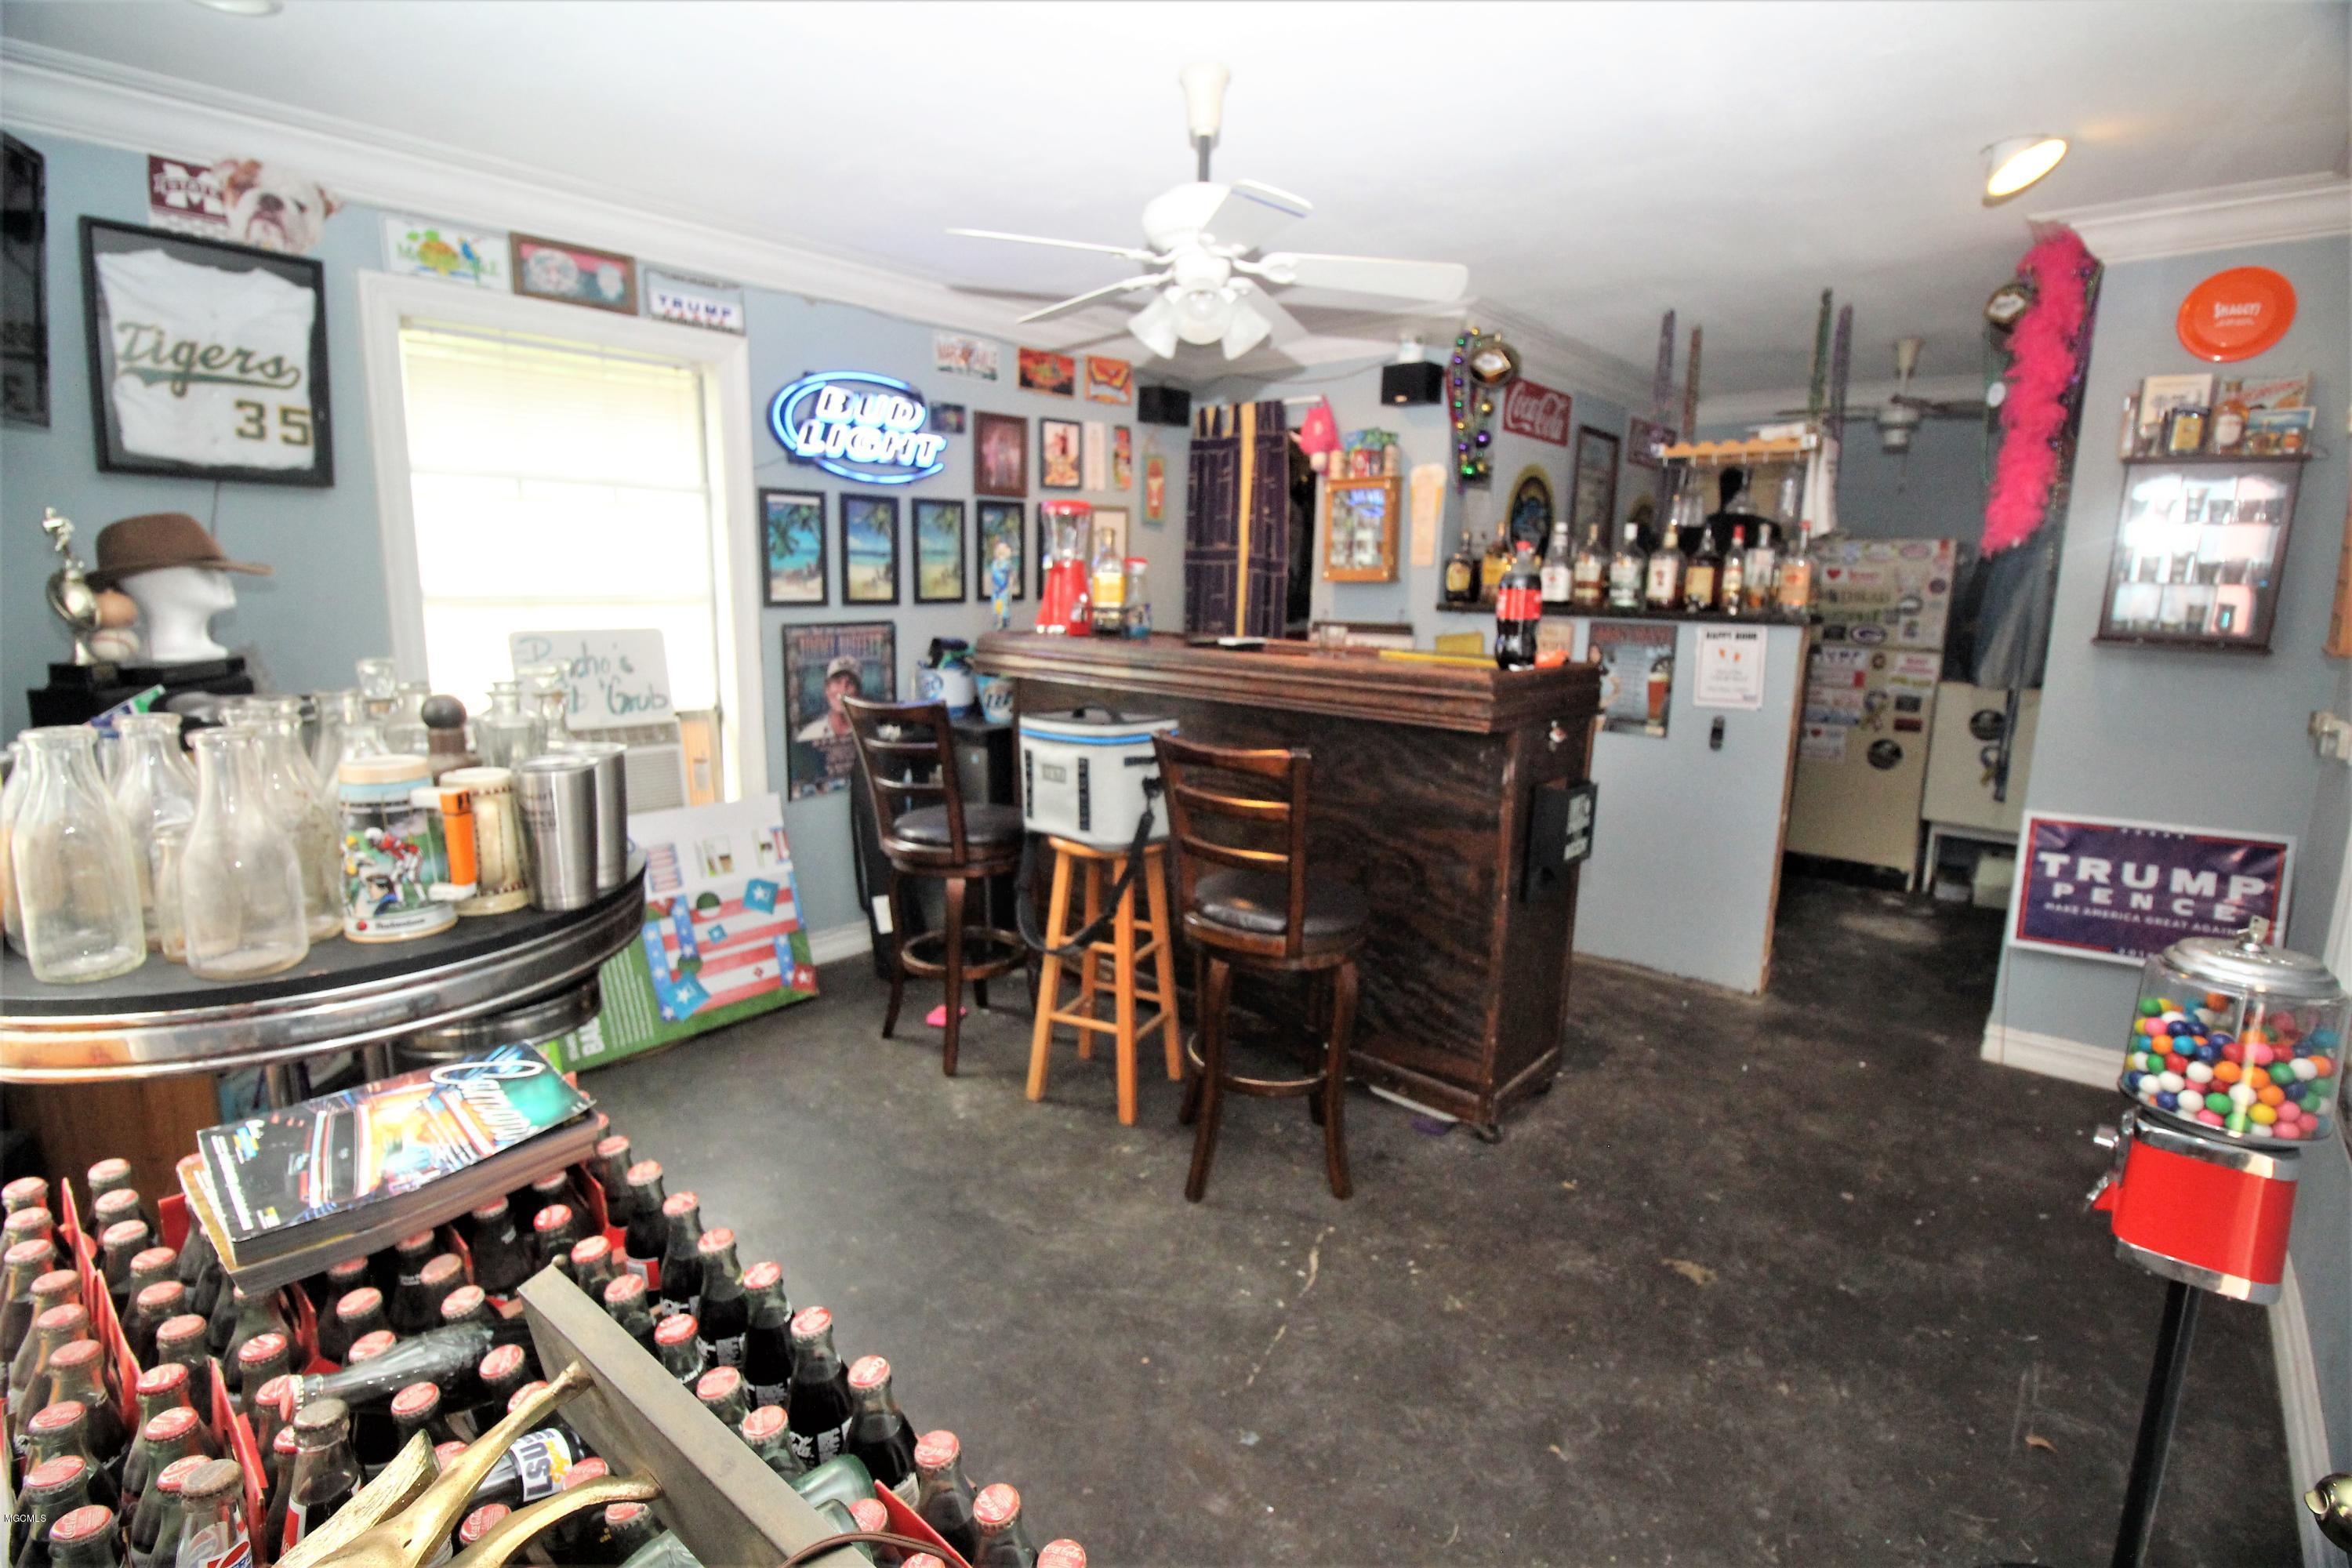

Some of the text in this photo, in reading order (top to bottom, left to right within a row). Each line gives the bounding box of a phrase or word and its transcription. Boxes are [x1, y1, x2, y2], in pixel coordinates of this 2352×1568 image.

[117, 321, 302, 397] Tigers
[235, 400, 313, 448] 35
[815, 385, 927, 432] BUD
[796, 418, 947, 468] LIGHT
[2038, 851, 2267, 901] TRUMP
[2044, 902, 2078, 915] MAKE
[2083, 906, 2141, 924] AMERICA
[2144, 915, 2187, 930] GREAT
[2053, 882, 2237, 922] PENCE
[520, 1441, 554, 1496] LSU
